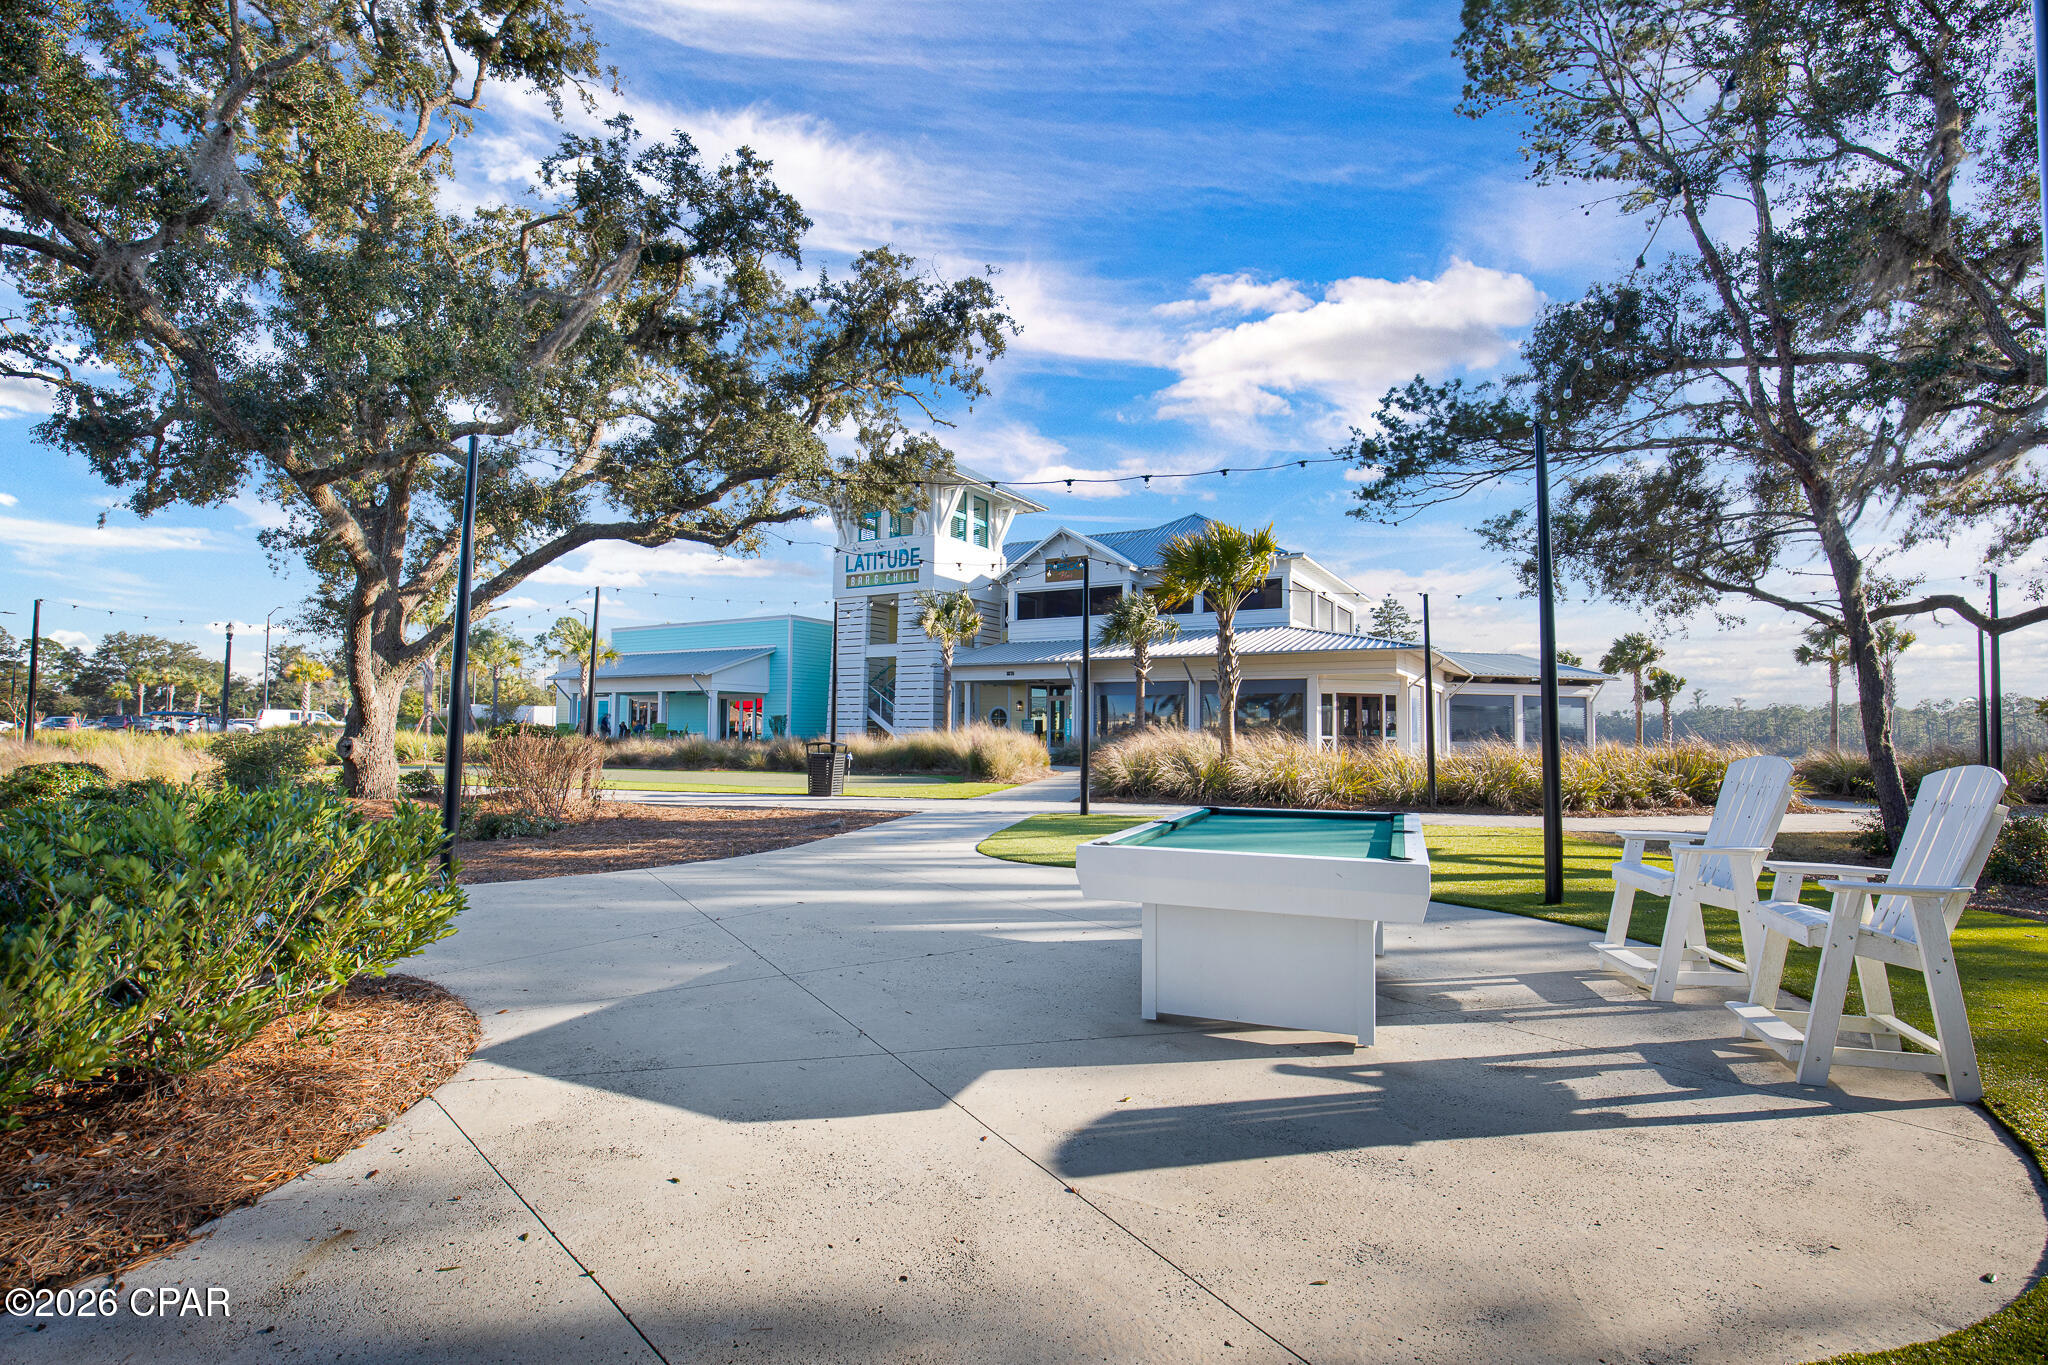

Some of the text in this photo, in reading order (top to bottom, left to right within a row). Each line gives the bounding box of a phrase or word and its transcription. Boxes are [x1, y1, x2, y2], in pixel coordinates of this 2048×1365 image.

[846, 547, 920, 573] LATITUDE
[850, 575, 870, 587] BAR
[886, 570, 917, 583] CHILL
